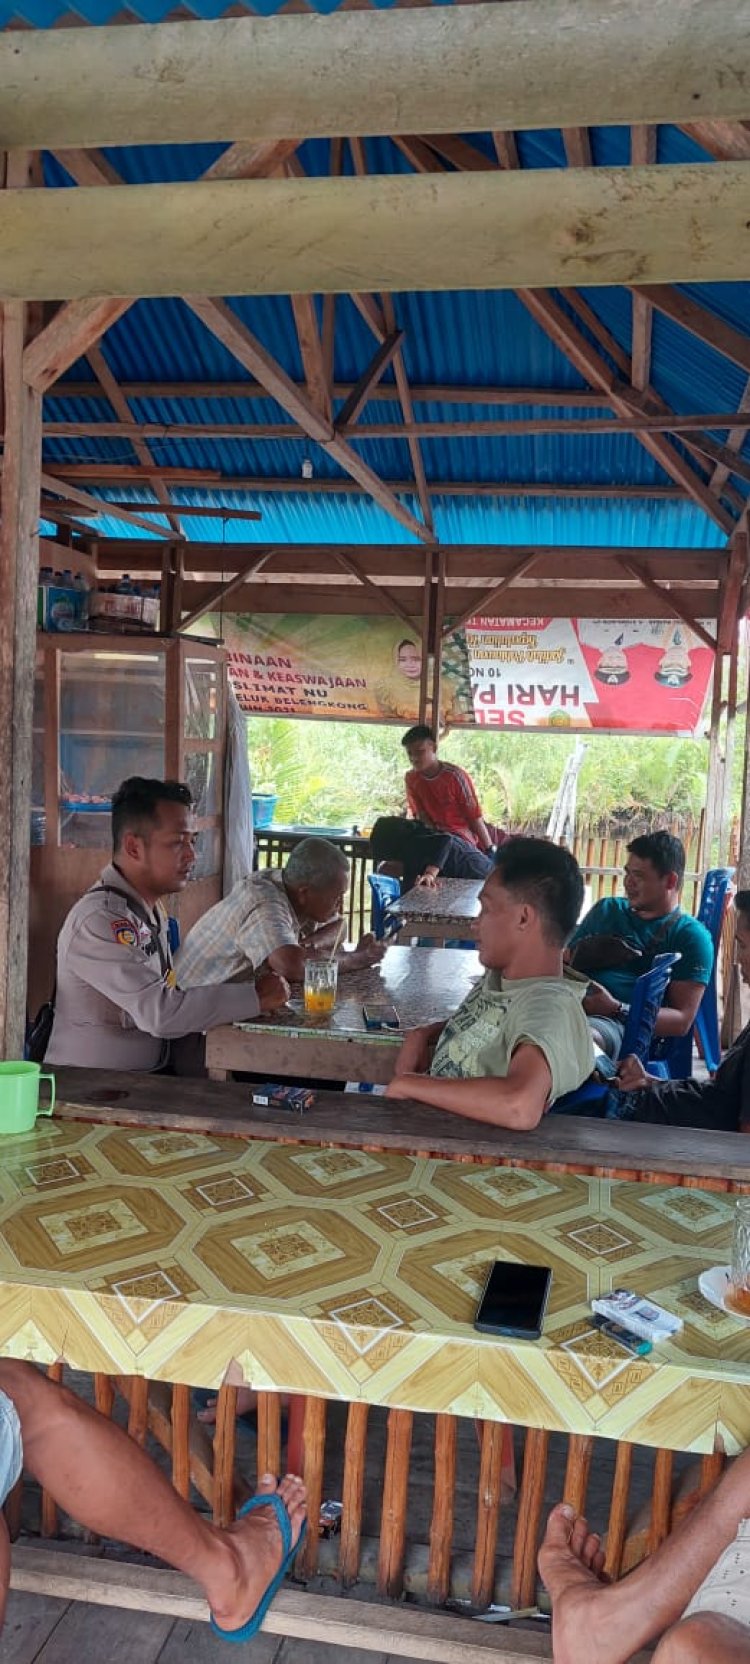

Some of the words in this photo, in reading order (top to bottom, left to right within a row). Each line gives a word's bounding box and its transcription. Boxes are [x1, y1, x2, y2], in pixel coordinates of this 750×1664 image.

[480, 617, 544, 627] KECAMATAN
[488, 667, 502, 677] 10
[267, 671, 367, 688] KEASWAJAAN
[303, 688, 328, 697] NU
[507, 684, 580, 706] HARI
